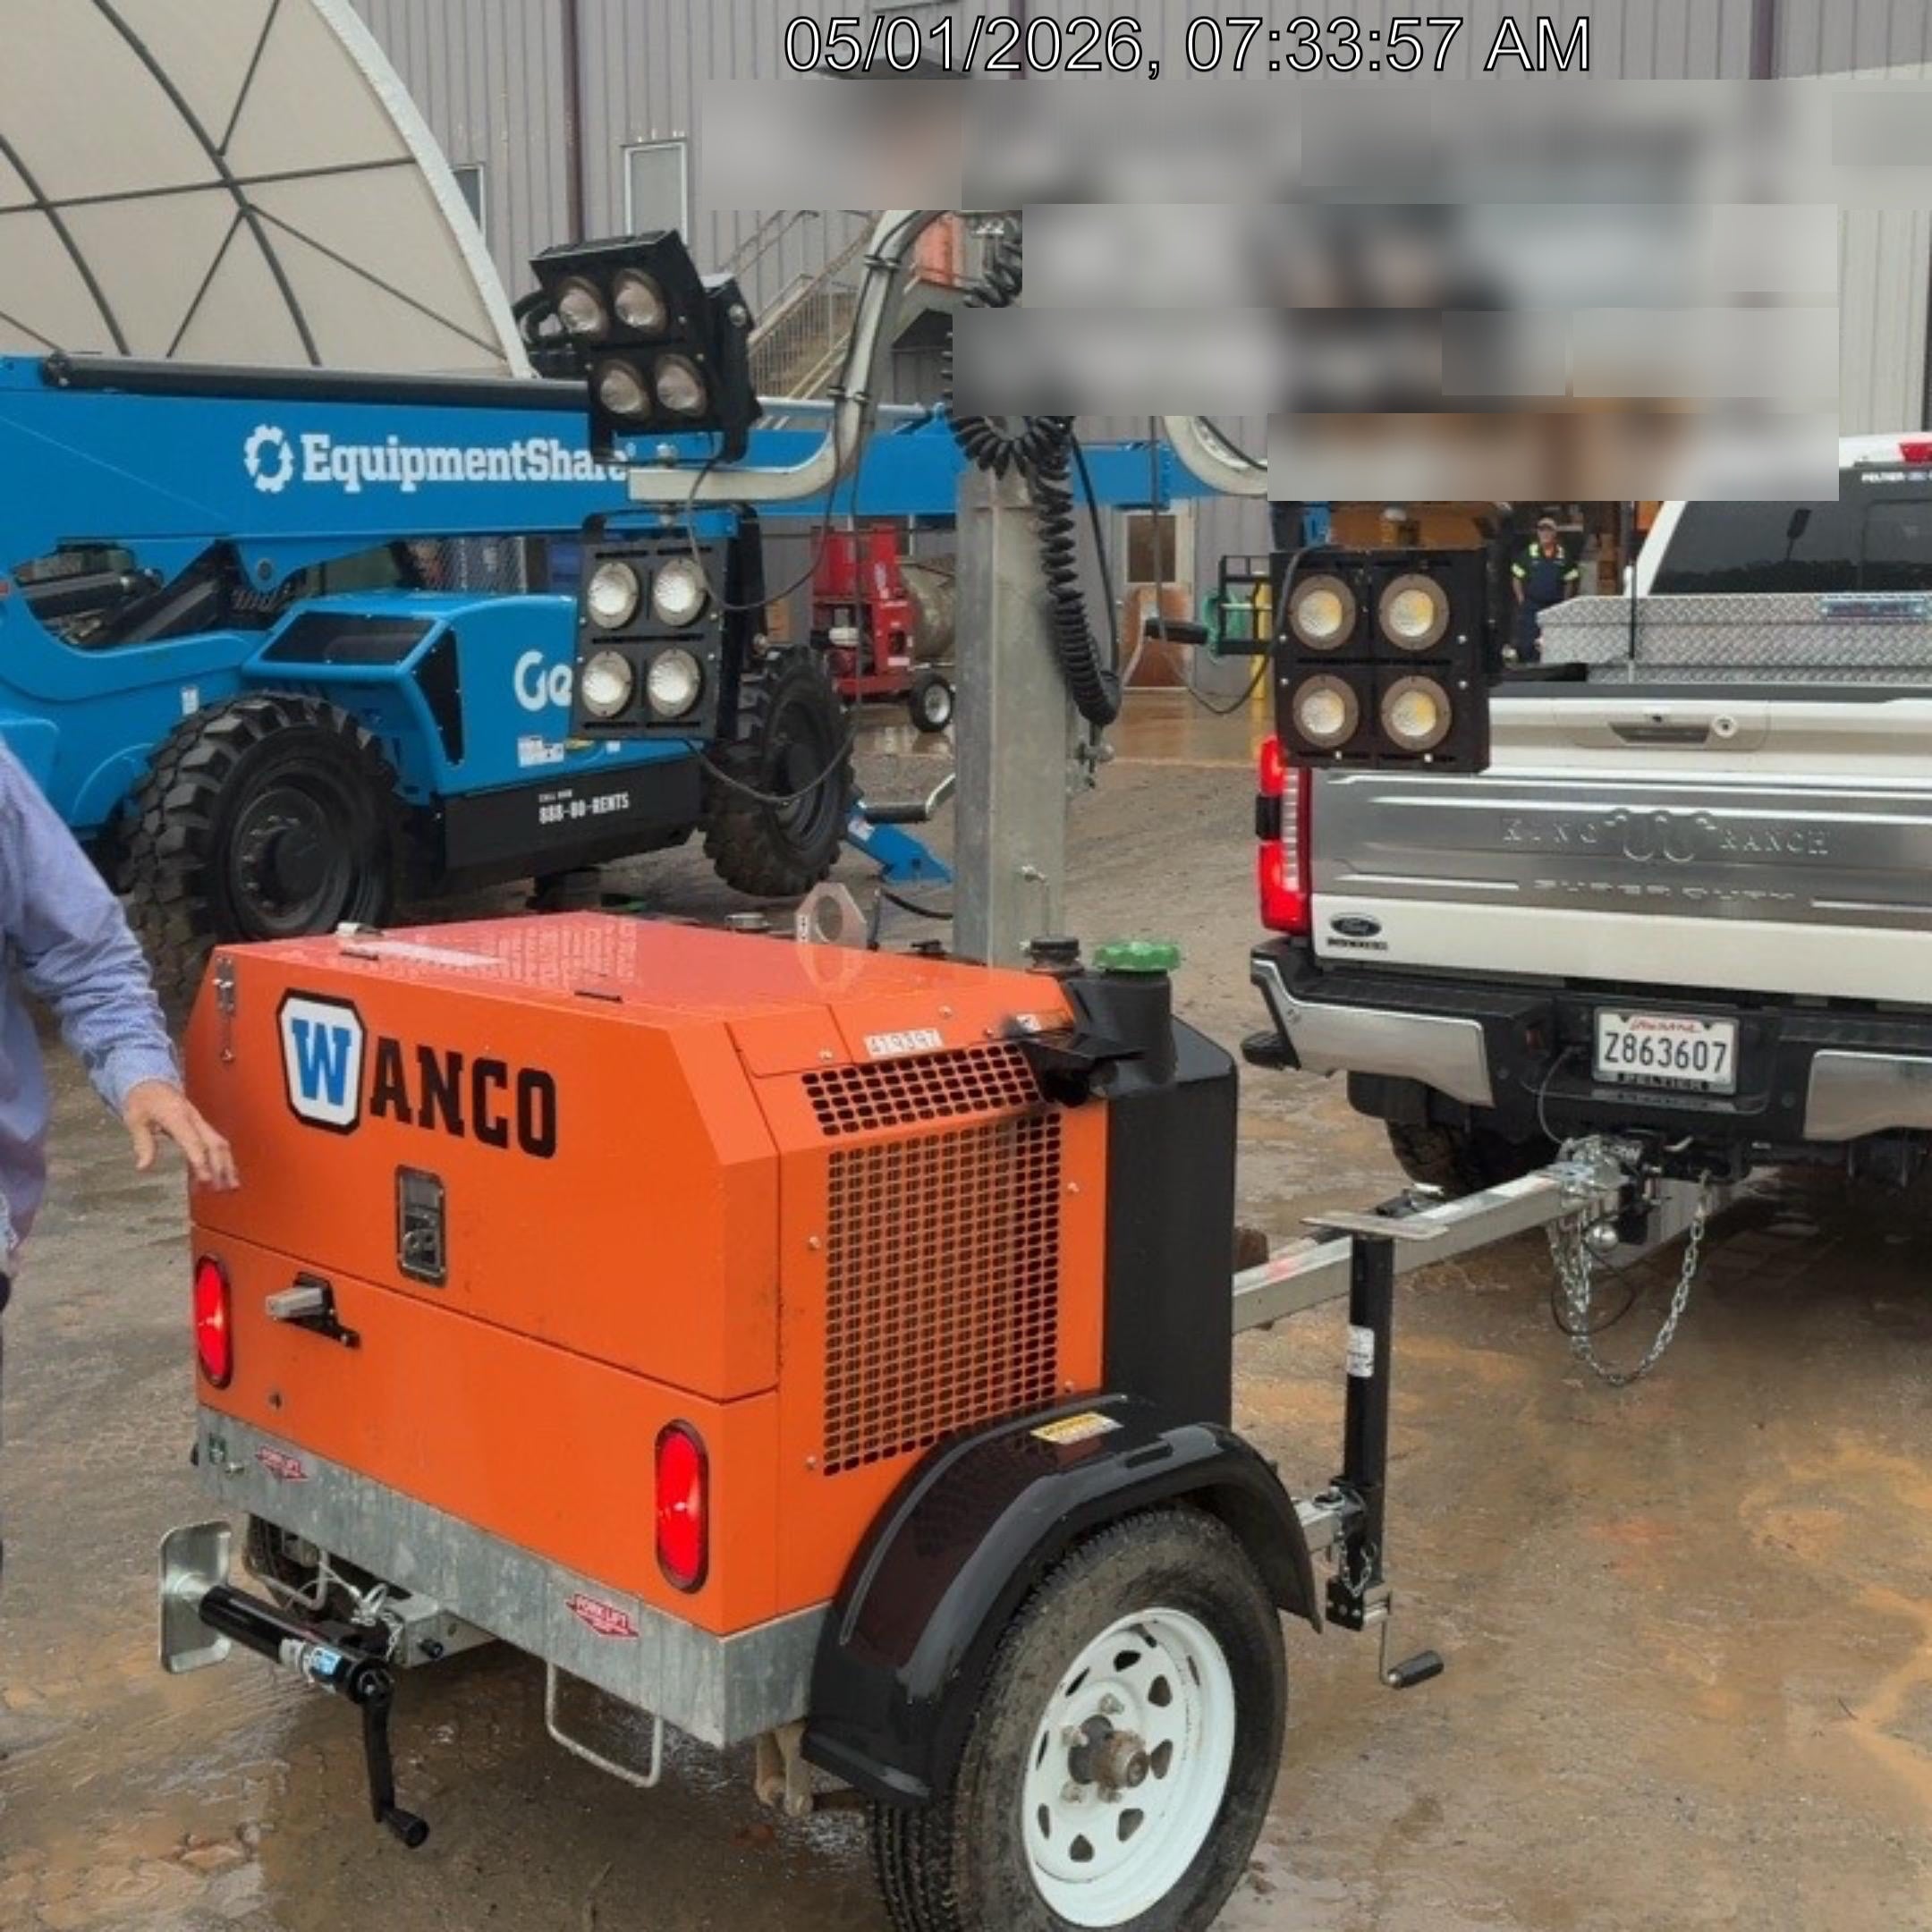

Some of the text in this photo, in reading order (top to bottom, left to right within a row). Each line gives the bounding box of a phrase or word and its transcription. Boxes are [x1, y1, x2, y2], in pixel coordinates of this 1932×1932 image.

[514, 649, 573, 712] Ge
[1604, 1031, 1727, 1073] Z863607
[291, 1017, 557, 1160] WANCO
